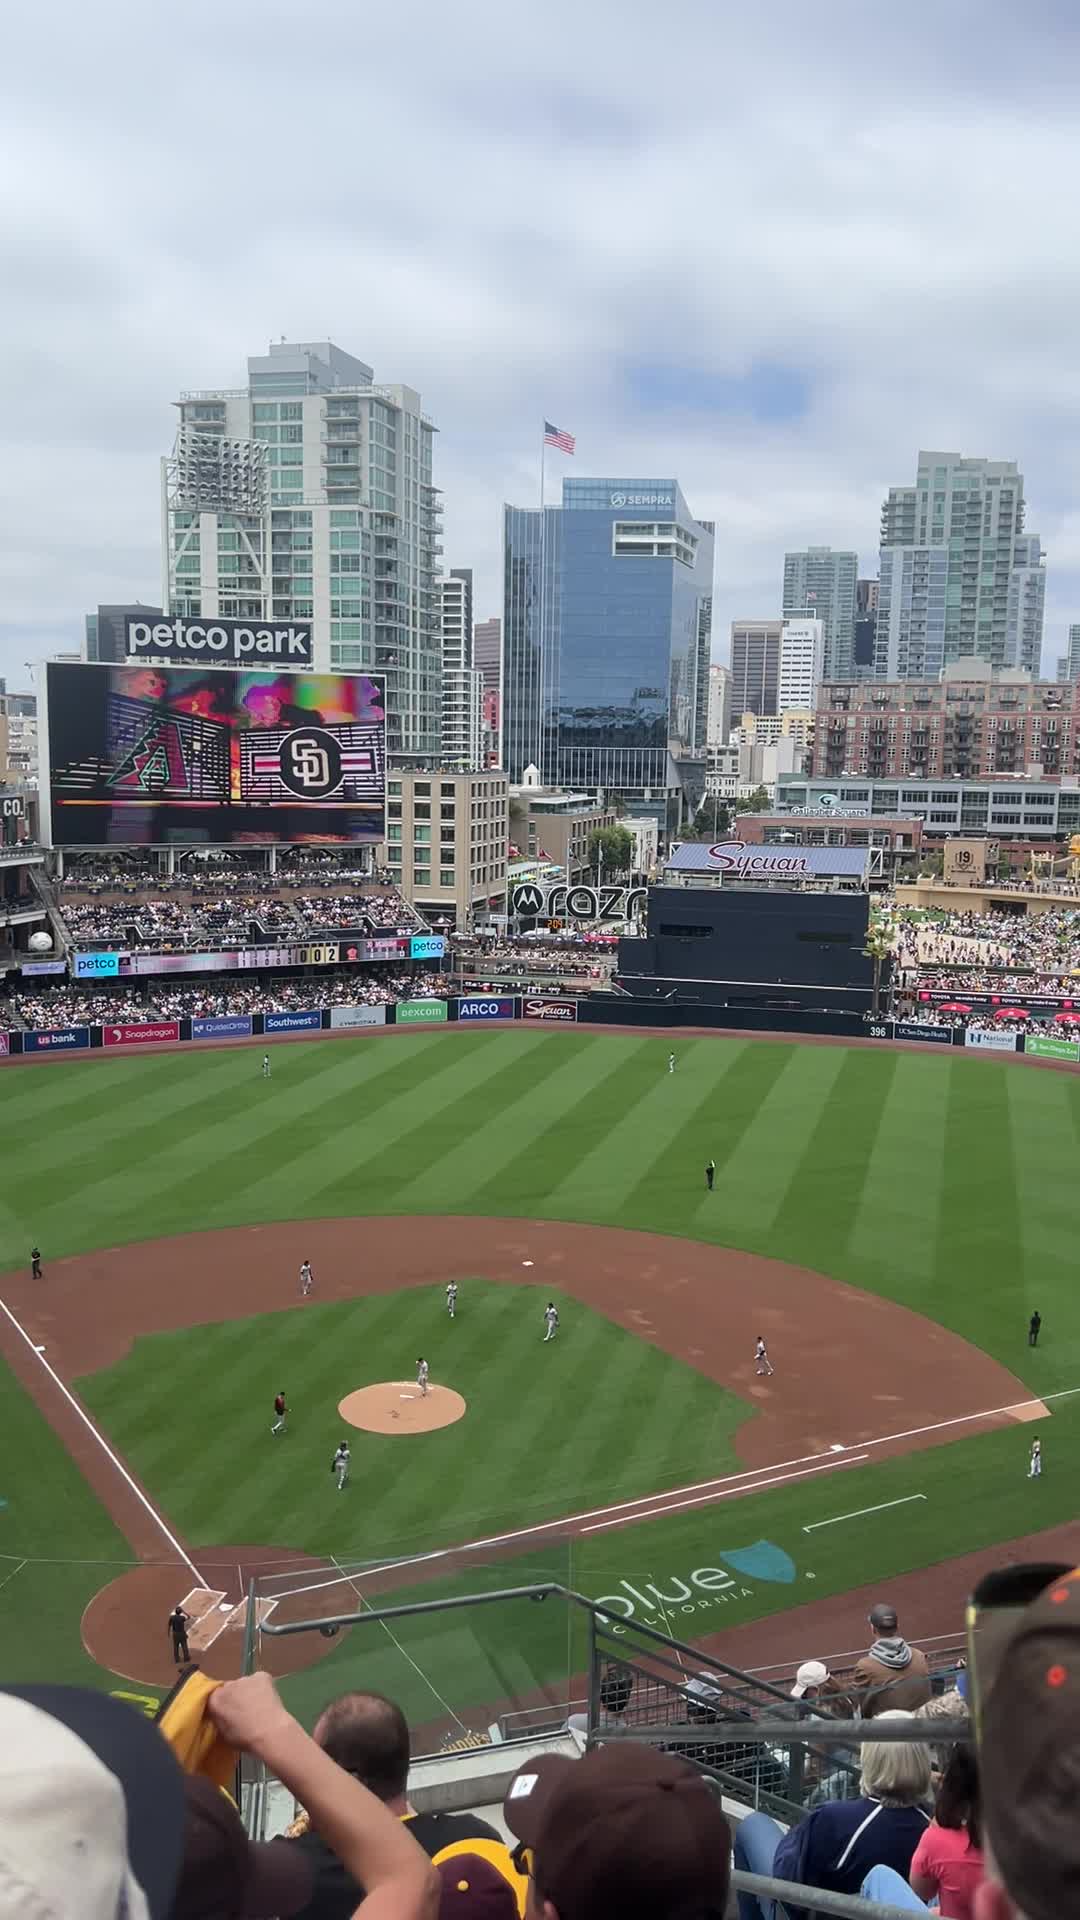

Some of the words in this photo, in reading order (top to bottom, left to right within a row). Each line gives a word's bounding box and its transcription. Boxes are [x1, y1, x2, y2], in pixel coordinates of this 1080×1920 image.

[627, 495, 673, 505] SEMPRA
[128, 619, 229, 654] petco
[234, 628, 308, 658] park
[791, 806, 835, 817] Gallagher
[835, 807, 867, 817] Square
[706, 840, 808, 879] Sycuan
[959, 851, 970, 863] 19
[547, 884, 649, 921] razr
[413, 940, 443, 952] petco
[77, 957, 116, 972] petco
[460, 1003, 499, 1016] ARCO
[526, 1000, 572, 1018] Sycuan
[267, 1015, 312, 1028] Southwest
[125, 1028, 175, 1040] Snapdragon
[870, 1026, 887, 1037] 396
[983, 1031, 1014, 1043] National
[38, 1035, 50, 1045] us
[52, 1033, 76, 1044] bank
[612, 1587, 755, 1635] CLIFORNIA
